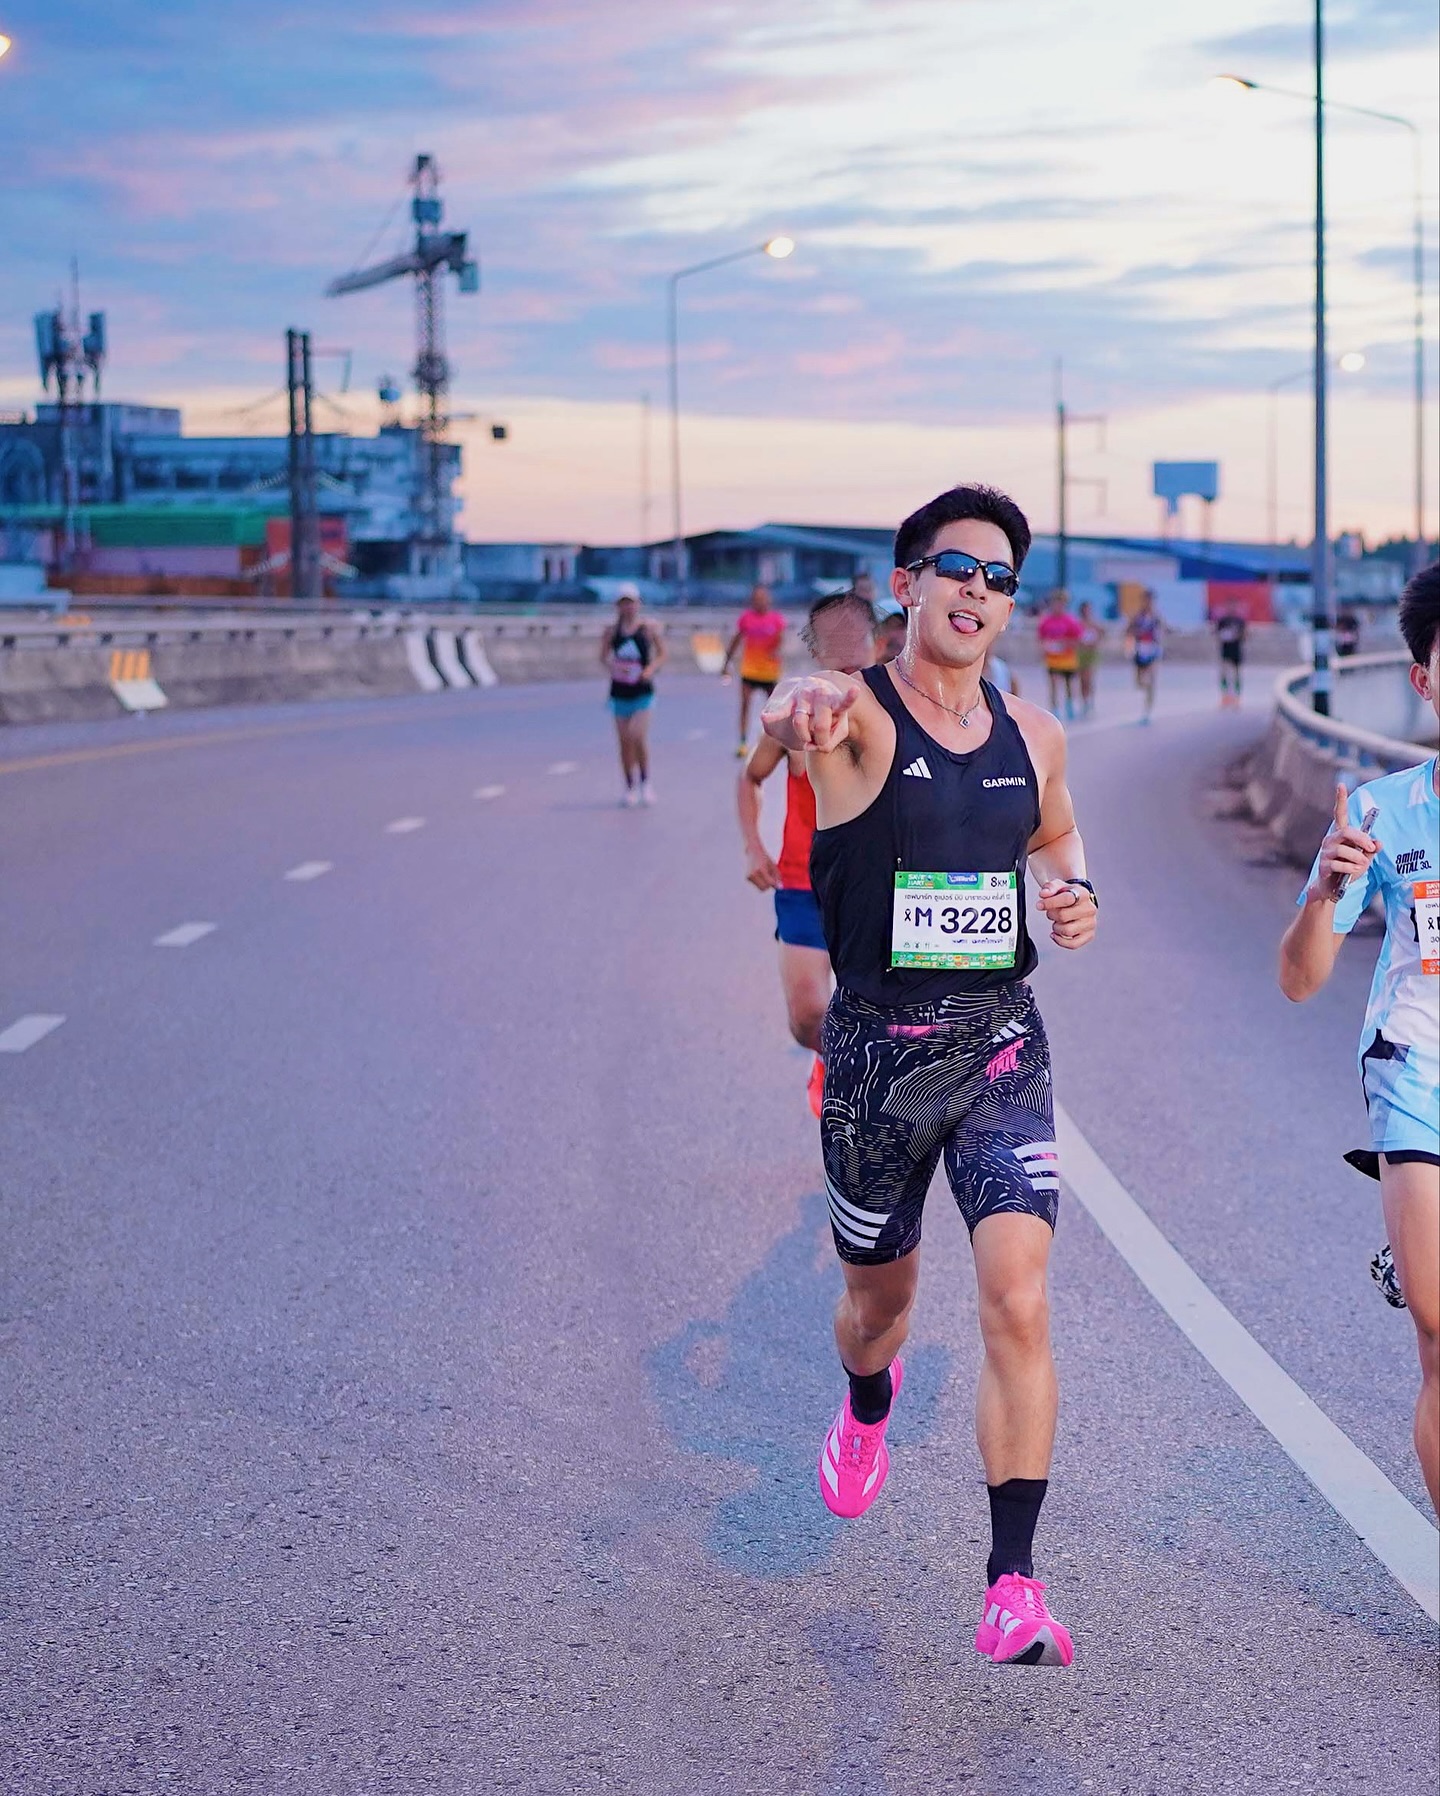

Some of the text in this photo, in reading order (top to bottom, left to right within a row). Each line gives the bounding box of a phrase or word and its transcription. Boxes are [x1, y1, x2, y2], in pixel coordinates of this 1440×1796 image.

[982, 777, 1026, 788] GARMIN
[1395, 848, 1425, 864] amino
[1396, 861, 1418, 874] VITAL
[914, 906, 1012, 934] M 3228
